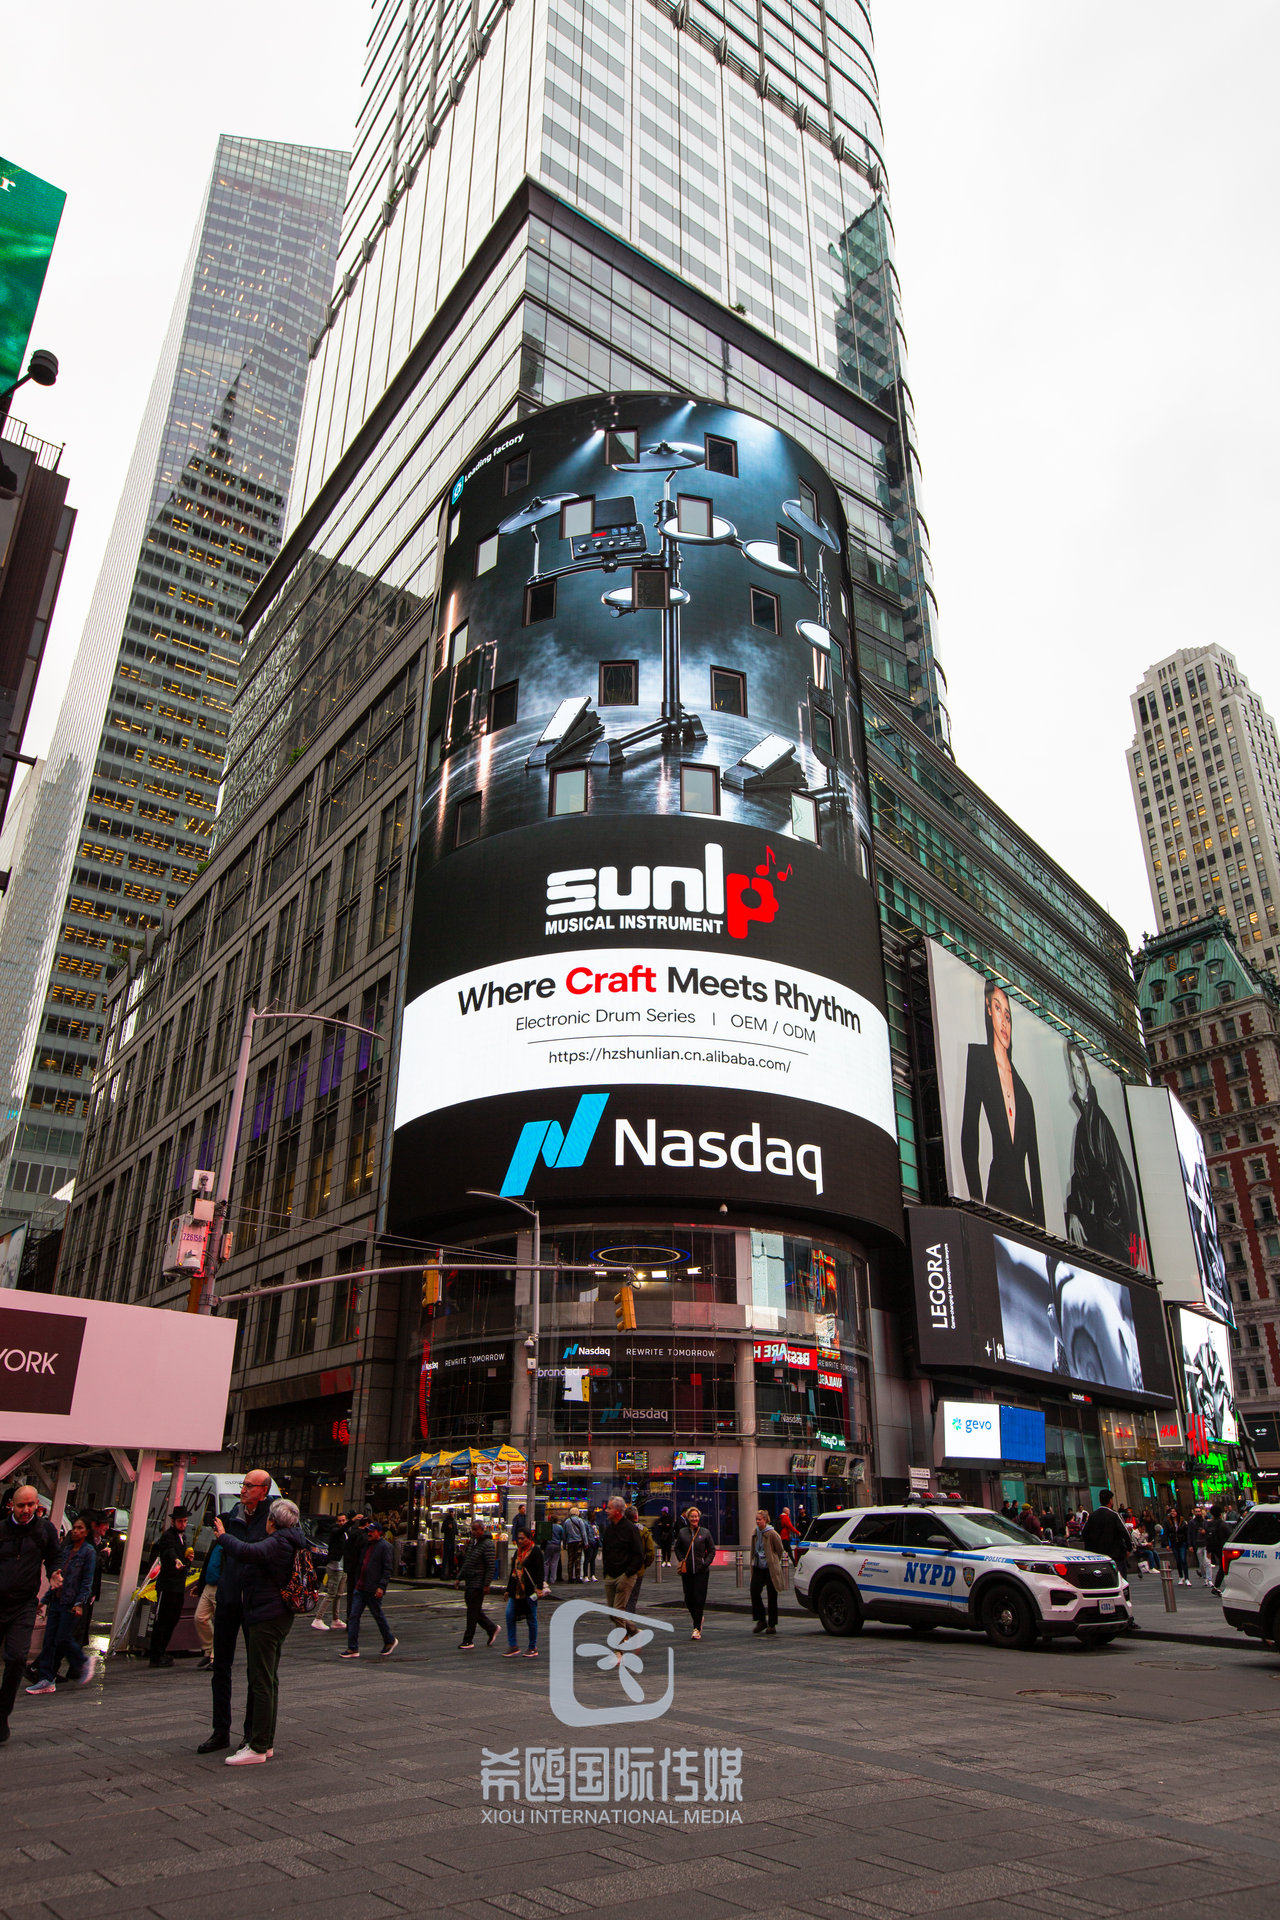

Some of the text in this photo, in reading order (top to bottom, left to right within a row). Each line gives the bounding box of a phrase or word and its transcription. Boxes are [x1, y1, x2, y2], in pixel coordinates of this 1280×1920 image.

[464, 433, 525, 483] Leading factory
[545, 915, 724, 935] MUSICAL INSTRUMENT
[457, 964, 862, 1034] Where Craft Meets Rhythm
[515, 1010, 591, 1031] Electronic
[595, 1009, 641, 1024] Drum
[646, 1008, 696, 1025] Series
[730, 1014, 768, 1032] OEM
[782, 1021, 816, 1043] ODM
[548, 1046, 792, 1074] https://hzshunlian.cn.alibaba.com/
[614, 1118, 823, 1196] Nasdaq
[925, 1243, 949, 1328] LEGORA
[444, 1357, 467, 1367] REWRITE
[468, 1353, 506, 1364] TOMORROW
[578, 1346, 716, 1357] Nasdaq REWRITE TOMORROW
[622, 1407, 669, 1422] Nasdaq
[965, 1419, 992, 1433] gevo
[984, 1555, 1006, 1563] POLICE
[903, 1561, 957, 1587] NYPD
